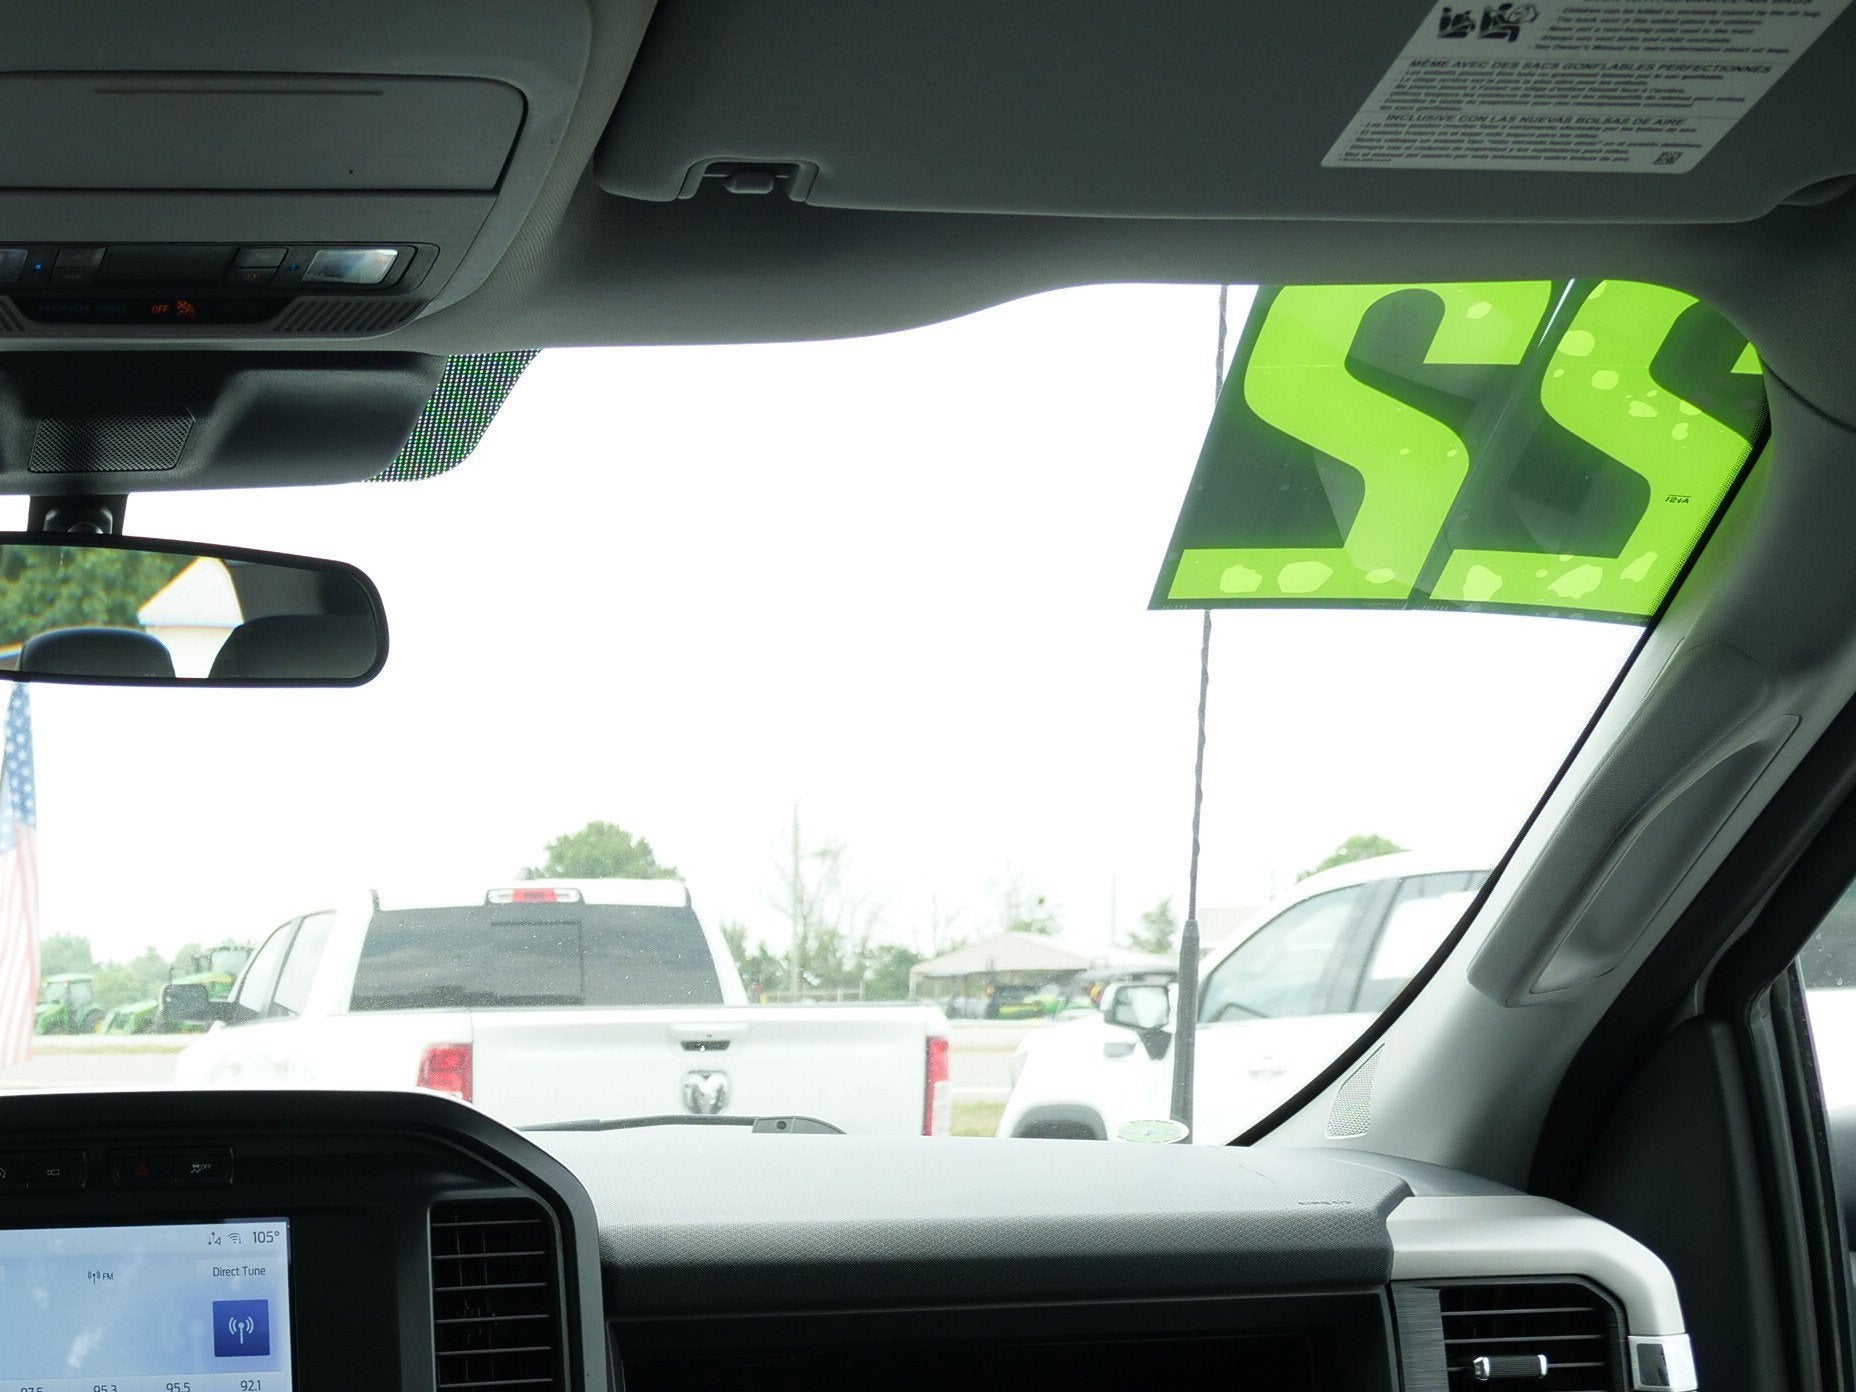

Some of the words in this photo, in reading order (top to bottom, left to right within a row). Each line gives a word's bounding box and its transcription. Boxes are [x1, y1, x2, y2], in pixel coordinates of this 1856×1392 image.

[1452, 60, 1488, 69] AVEC
[1492, 61, 1520, 69] DES
[1521, 62, 1560, 70] SACS
[1489, 115, 1518, 123] LAS
[1518, 116, 1573, 124] NUEVAS
[1574, 117, 1631, 125] BOLSAS
[1653, 118, 1686, 126] AIRE
[151, 304, 169, 314] OFF
[252, 1231, 280, 1244] 105°
[102, 1272, 114, 1280] FM
[212, 1266, 239, 1277] Direct
[242, 1265, 266, 1276] Tune
[240, 1380, 262, 1392] 92.1
